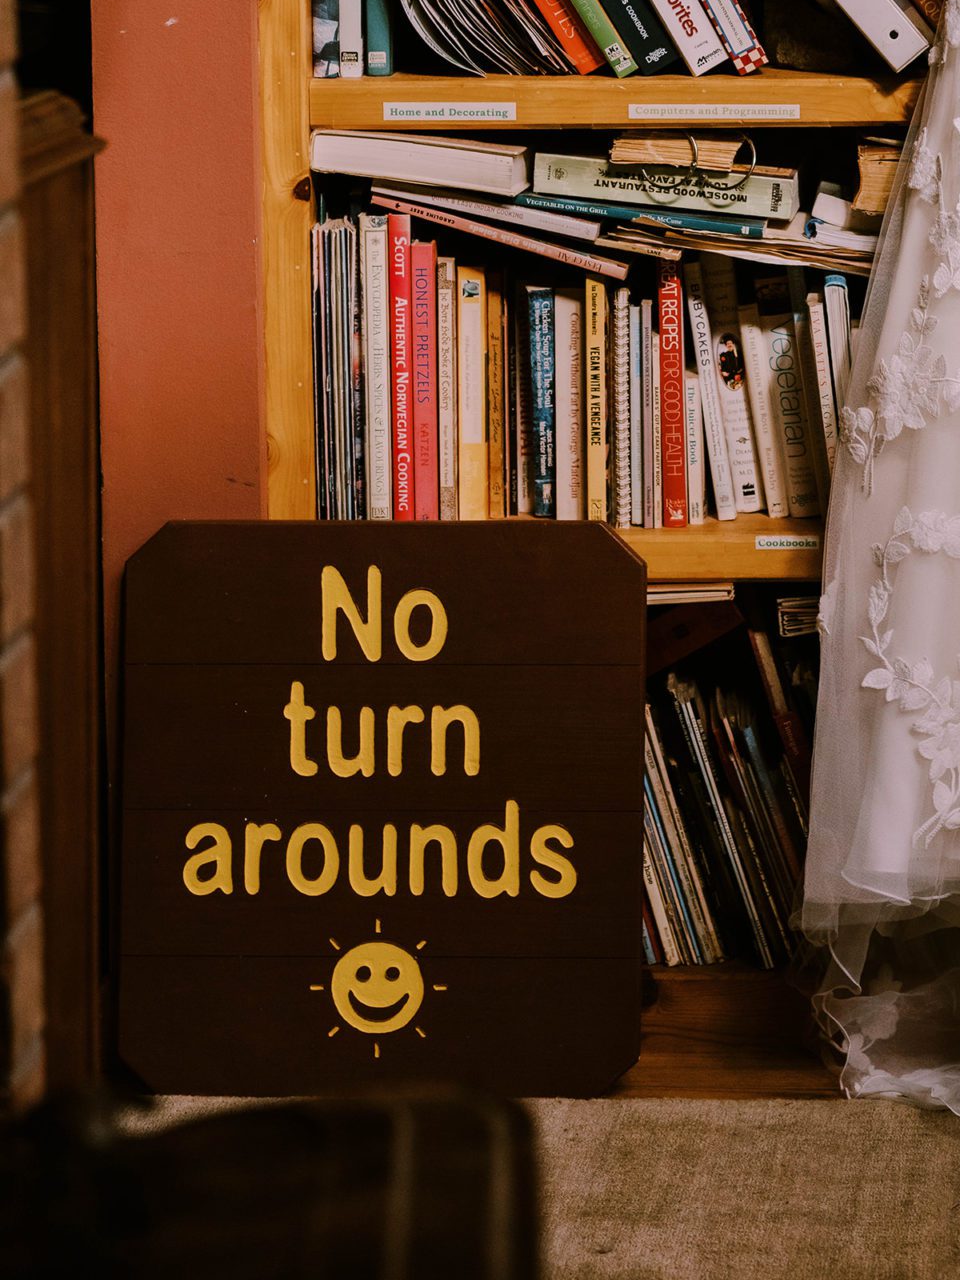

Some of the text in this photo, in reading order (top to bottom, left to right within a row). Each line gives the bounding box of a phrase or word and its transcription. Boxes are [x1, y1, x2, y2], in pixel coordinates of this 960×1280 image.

[390, 107, 508, 118] Home and Decorating
[634, 106, 795, 118] Computers and Programming
[394, 236, 407, 277] SCOTT
[416, 268, 430, 404] HONEST PRETZELS
[689, 284, 711, 367] BABYCAKES
[591, 346, 600, 372] VEGAN
[591, 374, 600, 392] WITH
[770, 320, 808, 460] Vegetarian
[396, 297, 410, 511] AUTHENTIC NORWEGIAN COOKING
[591, 401, 601, 447] VENGEANCE
[758, 538, 817, 548] Cookbooks
[321, 565, 448, 662] No
[283, 681, 480, 777] turn
[182, 799, 577, 899] arounds
